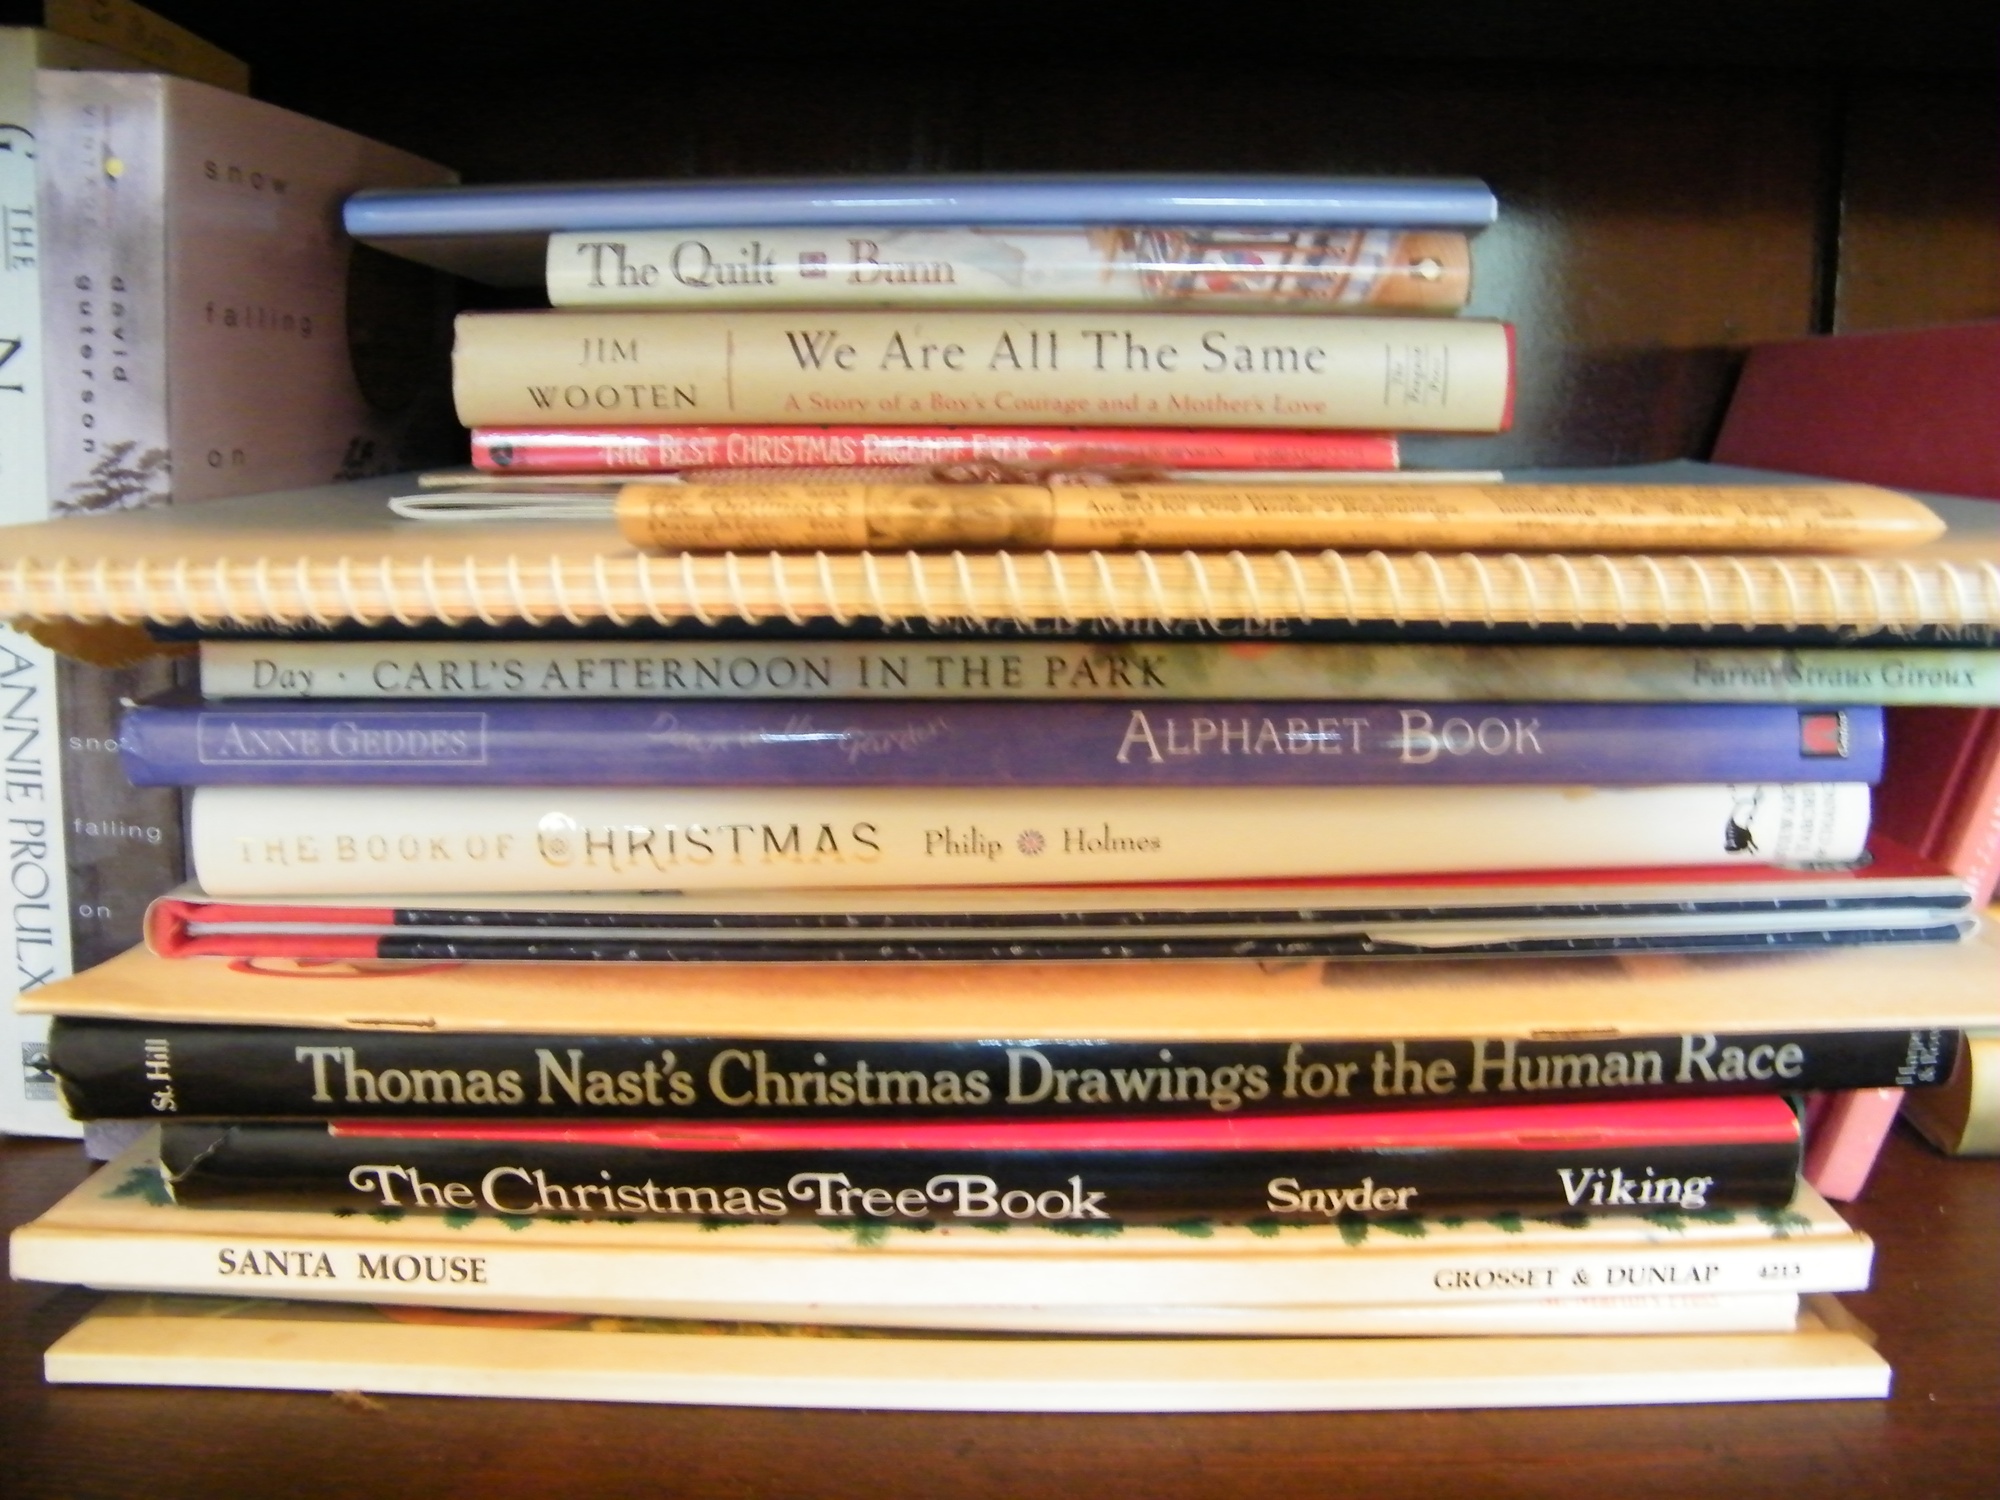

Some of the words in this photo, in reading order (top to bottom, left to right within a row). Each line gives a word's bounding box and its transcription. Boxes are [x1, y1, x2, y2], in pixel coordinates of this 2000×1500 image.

[205, 160, 288, 195] snow
[577, 241, 660, 289] The
[669, 240, 778, 289] Quilt
[111, 275, 128, 384] david
[206, 301, 314, 340] falling
[74, 275, 97, 454] guterson
[579, 335, 641, 367] JIM
[784, 329, 857, 372] We
[879, 329, 966, 372] Are
[987, 329, 1060, 373] All
[1080, 328, 1179, 374] The
[1200, 329, 1328, 375] Same
[526, 383, 698, 410] WOOTEN
[785, 393, 802, 412] A
[808, 391, 869, 416] Story
[878, 392, 900, 412] of
[909, 399, 922, 412] a
[994, 390, 1090, 418] Courage
[1099, 394, 1140, 413] and
[1147, 400, 1160, 414] a
[1273, 393, 1328, 414] Love
[207, 450, 246, 469] on
[252, 659, 314, 696] Day
[372, 658, 524, 692] CARL'S
[540, 656, 832, 692] AFTERNOON
[860, 656, 908, 688] IN
[924, 655, 1033, 688] THE
[1045, 655, 1170, 689] PARK
[1880, 659, 1976, 689] Giroux
[0, 642, 45, 804] ANNIE
[218, 720, 323, 757] ANNE
[328, 720, 469, 757] GEDDES
[1116, 709, 1370, 764] ALPHABET
[1398, 708, 1544, 765] BOOK
[69, 735, 120, 753] sno
[72, 816, 163, 844] falling
[536, 812, 882, 873] CHRISTMAS
[924, 826, 1001, 861] Philip
[1062, 823, 1162, 854] Holmes
[237, 834, 320, 866] THE
[336, 834, 451, 864] BOOK
[465, 833, 514, 862] OF
[8, 817, 57, 994] PROULX
[79, 901, 111, 919] on
[144, 1038, 172, 1081] Hill
[295, 1045, 526, 1107] Thomas
[534, 1047, 698, 1107] Nast's
[708, 1049, 992, 1107] Christmas
[1005, 1048, 1270, 1112] Drawings
[1283, 1042, 1358, 1099] for
[1370, 1042, 1459, 1097] the
[1470, 1038, 1668, 1095] Human
[1676, 1033, 1807, 1081] Race
[348, 1164, 478, 1210] The
[481, 1166, 788, 1218] Christmas
[787, 1172, 931, 1217] Tree
[924, 1174, 1111, 1221] Book
[1266, 1177, 1418, 1216] Snyder
[1556, 1167, 1713, 1210] Viking
[218, 1248, 337, 1280] SANTA
[357, 1251, 488, 1284] MOUSE
[1433, 1265, 1558, 1293] GROSSET
[1571, 1266, 1591, 1289] &
[1605, 1263, 1720, 1288] DUNLAP
